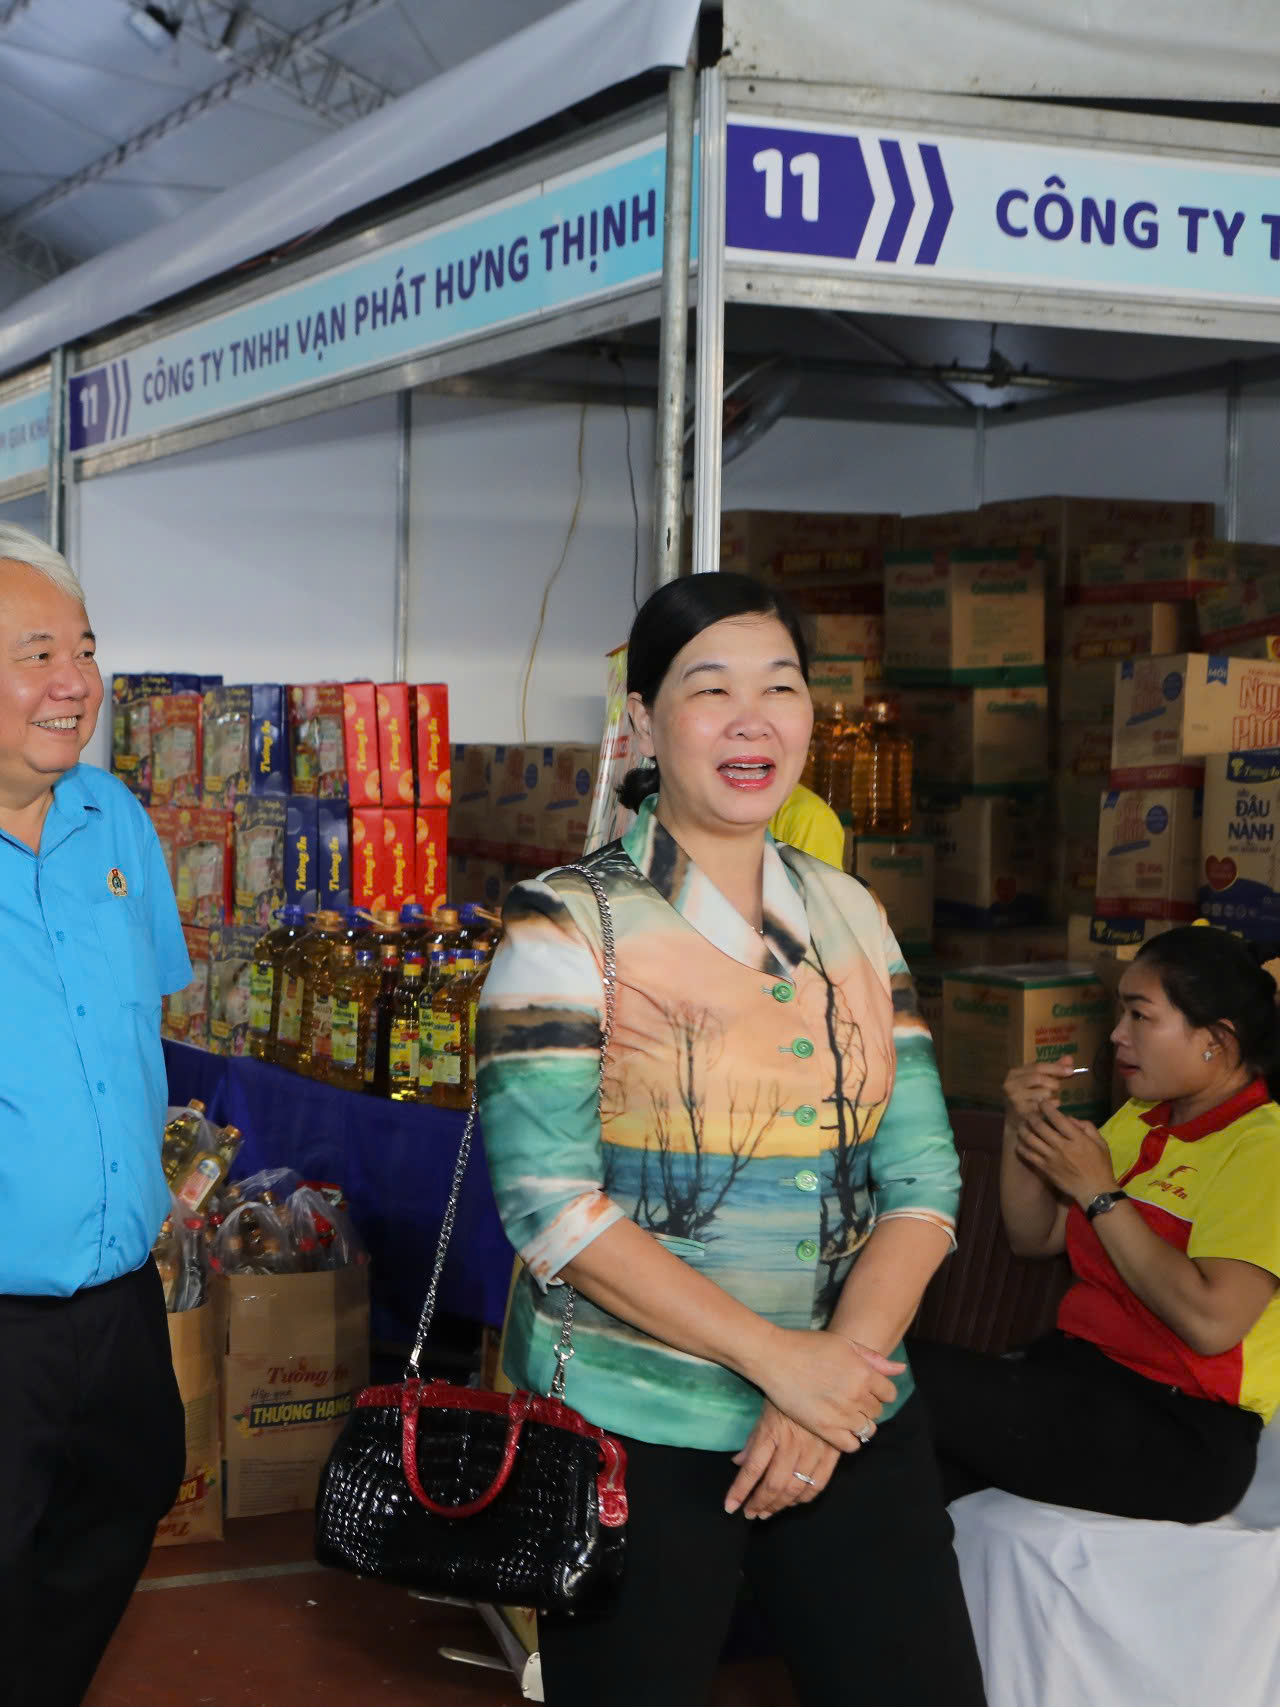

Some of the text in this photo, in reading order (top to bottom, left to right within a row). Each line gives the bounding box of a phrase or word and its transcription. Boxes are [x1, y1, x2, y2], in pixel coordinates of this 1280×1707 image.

[753, 148, 820, 223] 11
[996, 174, 1159, 250] CÔNG
[1178, 206, 1246, 257] TY
[143, 188, 656, 405] CÔNG TY TNHH VẠN PHÁT HƯNG THỊNH
[78, 382, 101, 429] 11
[1228, 818, 1274, 842] NÀNH
[1236, 794, 1271, 820] ĐẬU
[253, 1402, 314, 1427] THƯỢNG
